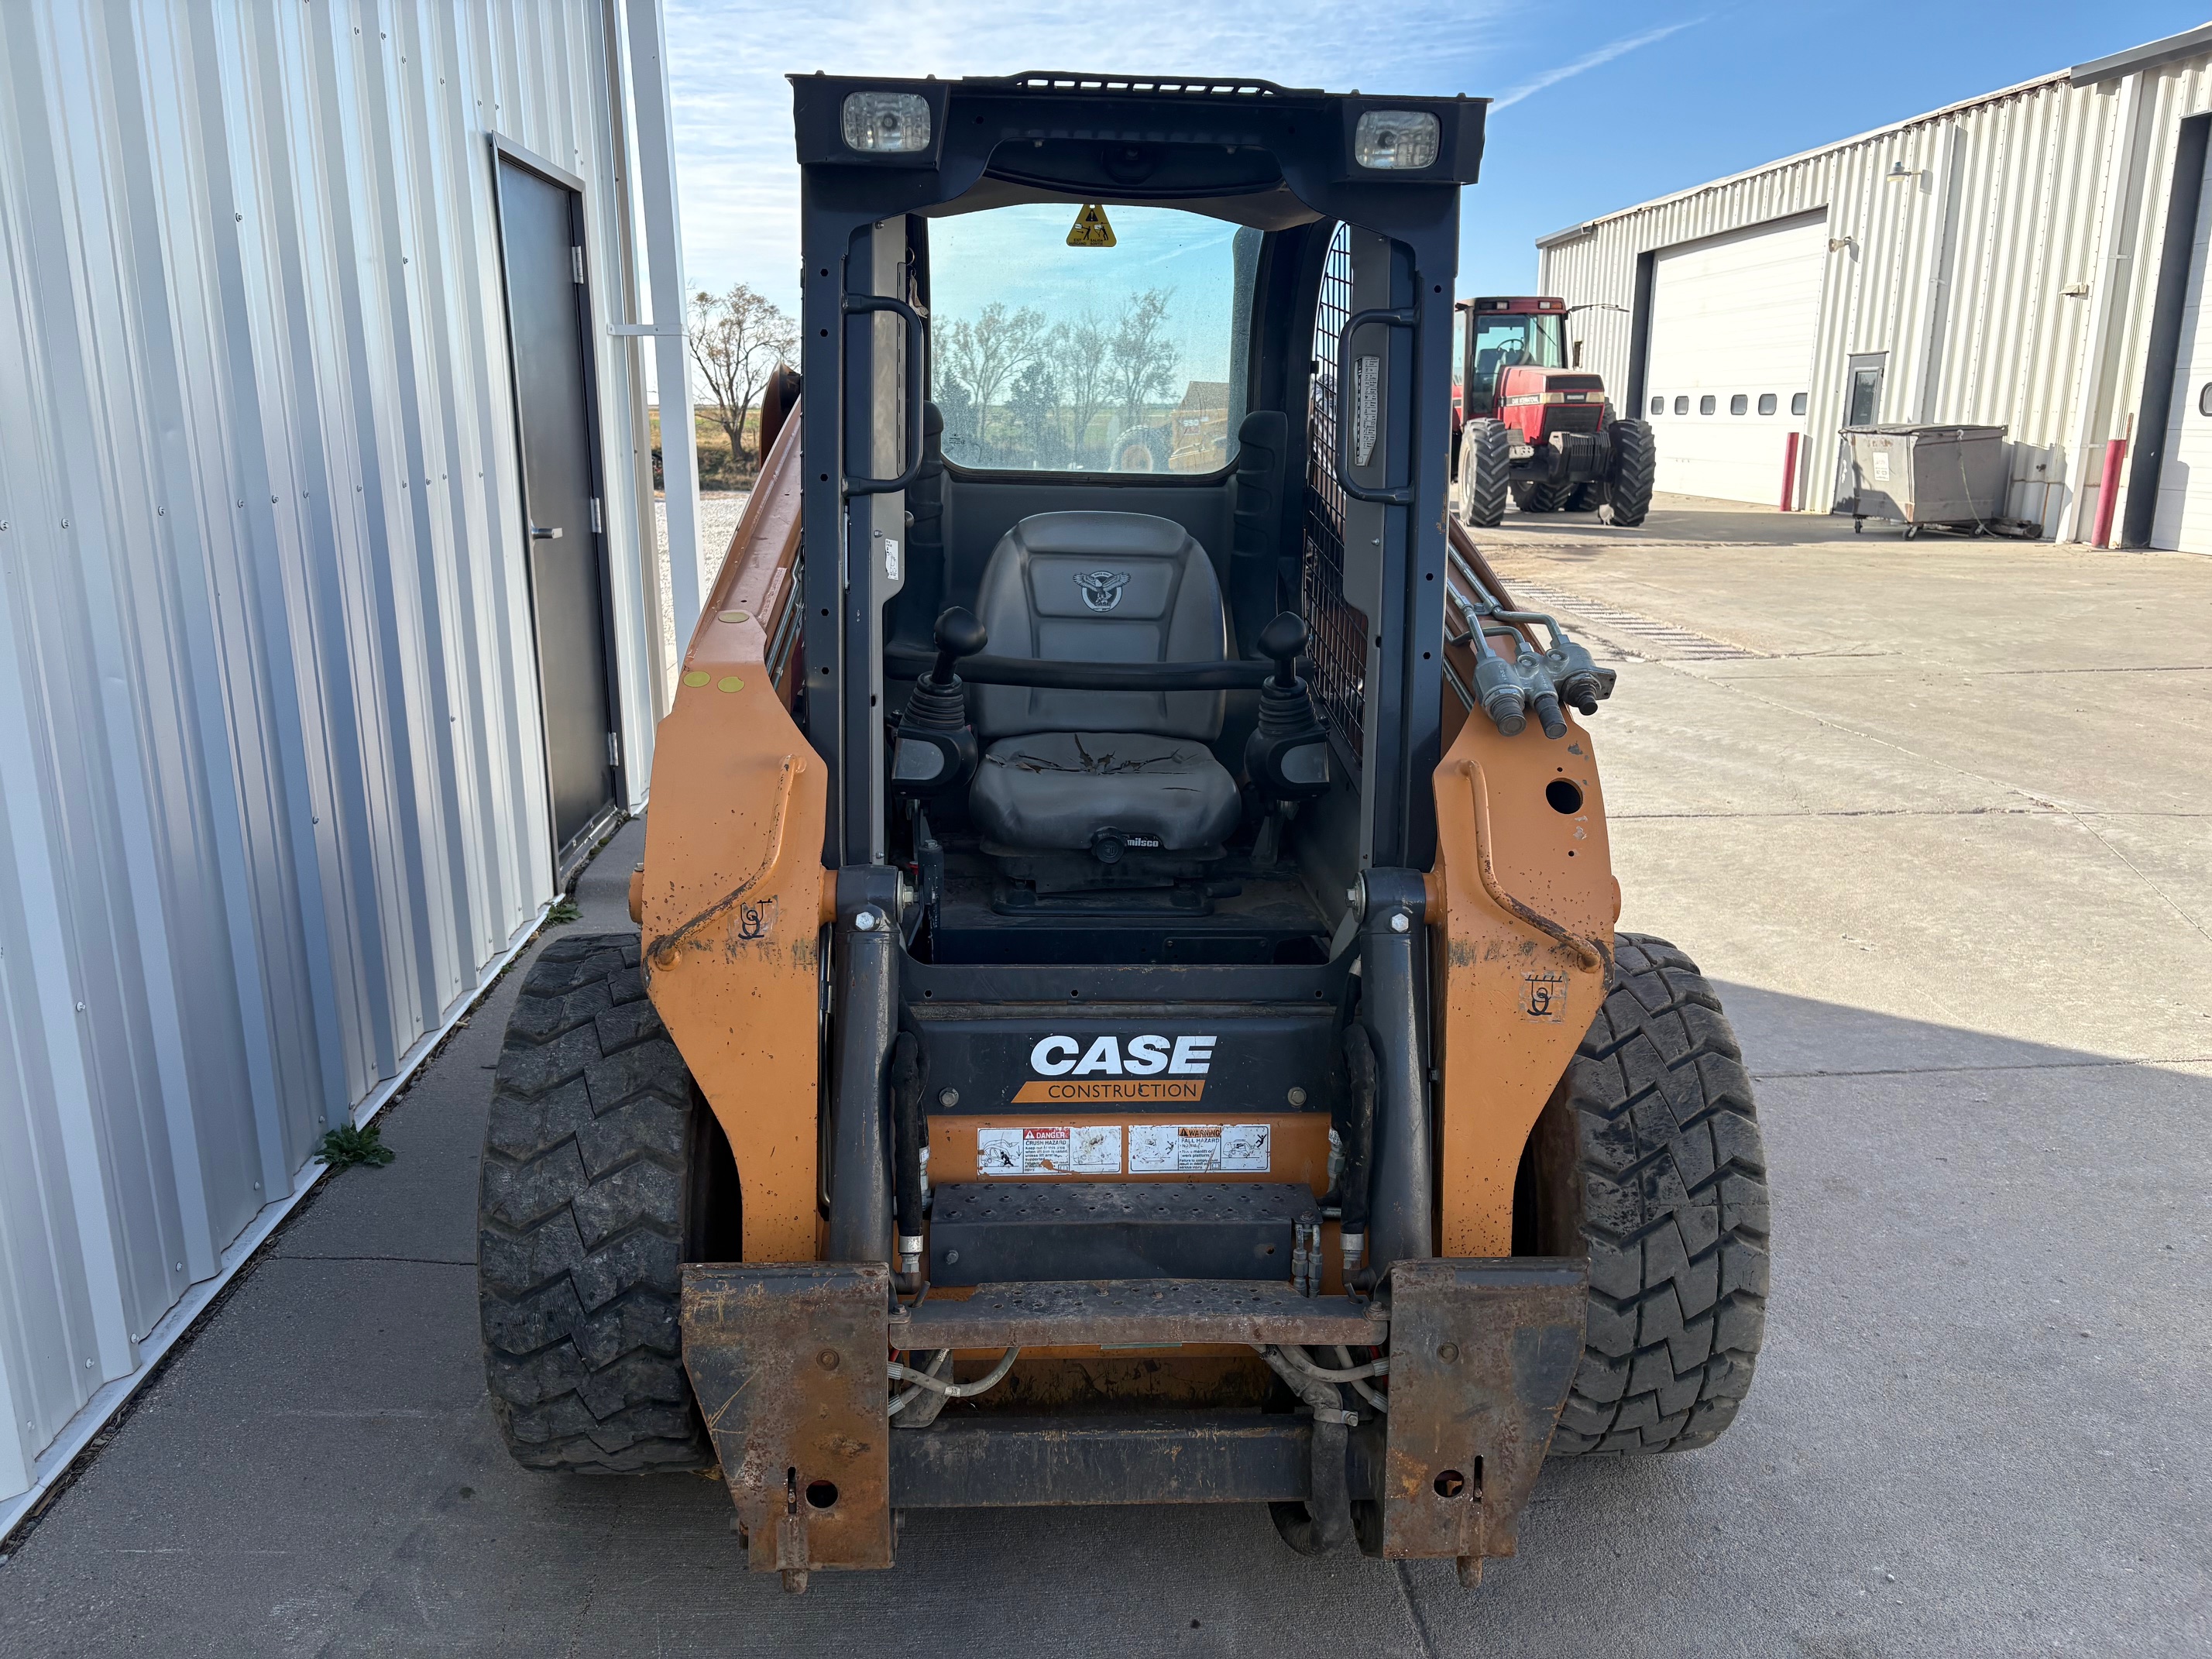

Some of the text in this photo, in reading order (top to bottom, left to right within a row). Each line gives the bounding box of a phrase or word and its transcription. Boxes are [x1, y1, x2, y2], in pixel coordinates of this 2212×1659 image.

[1127, 837, 1159, 847] milsco
[1030, 1034, 1218, 1076] CASE
[1048, 1084, 1197, 1099] CONSTRUCTION
